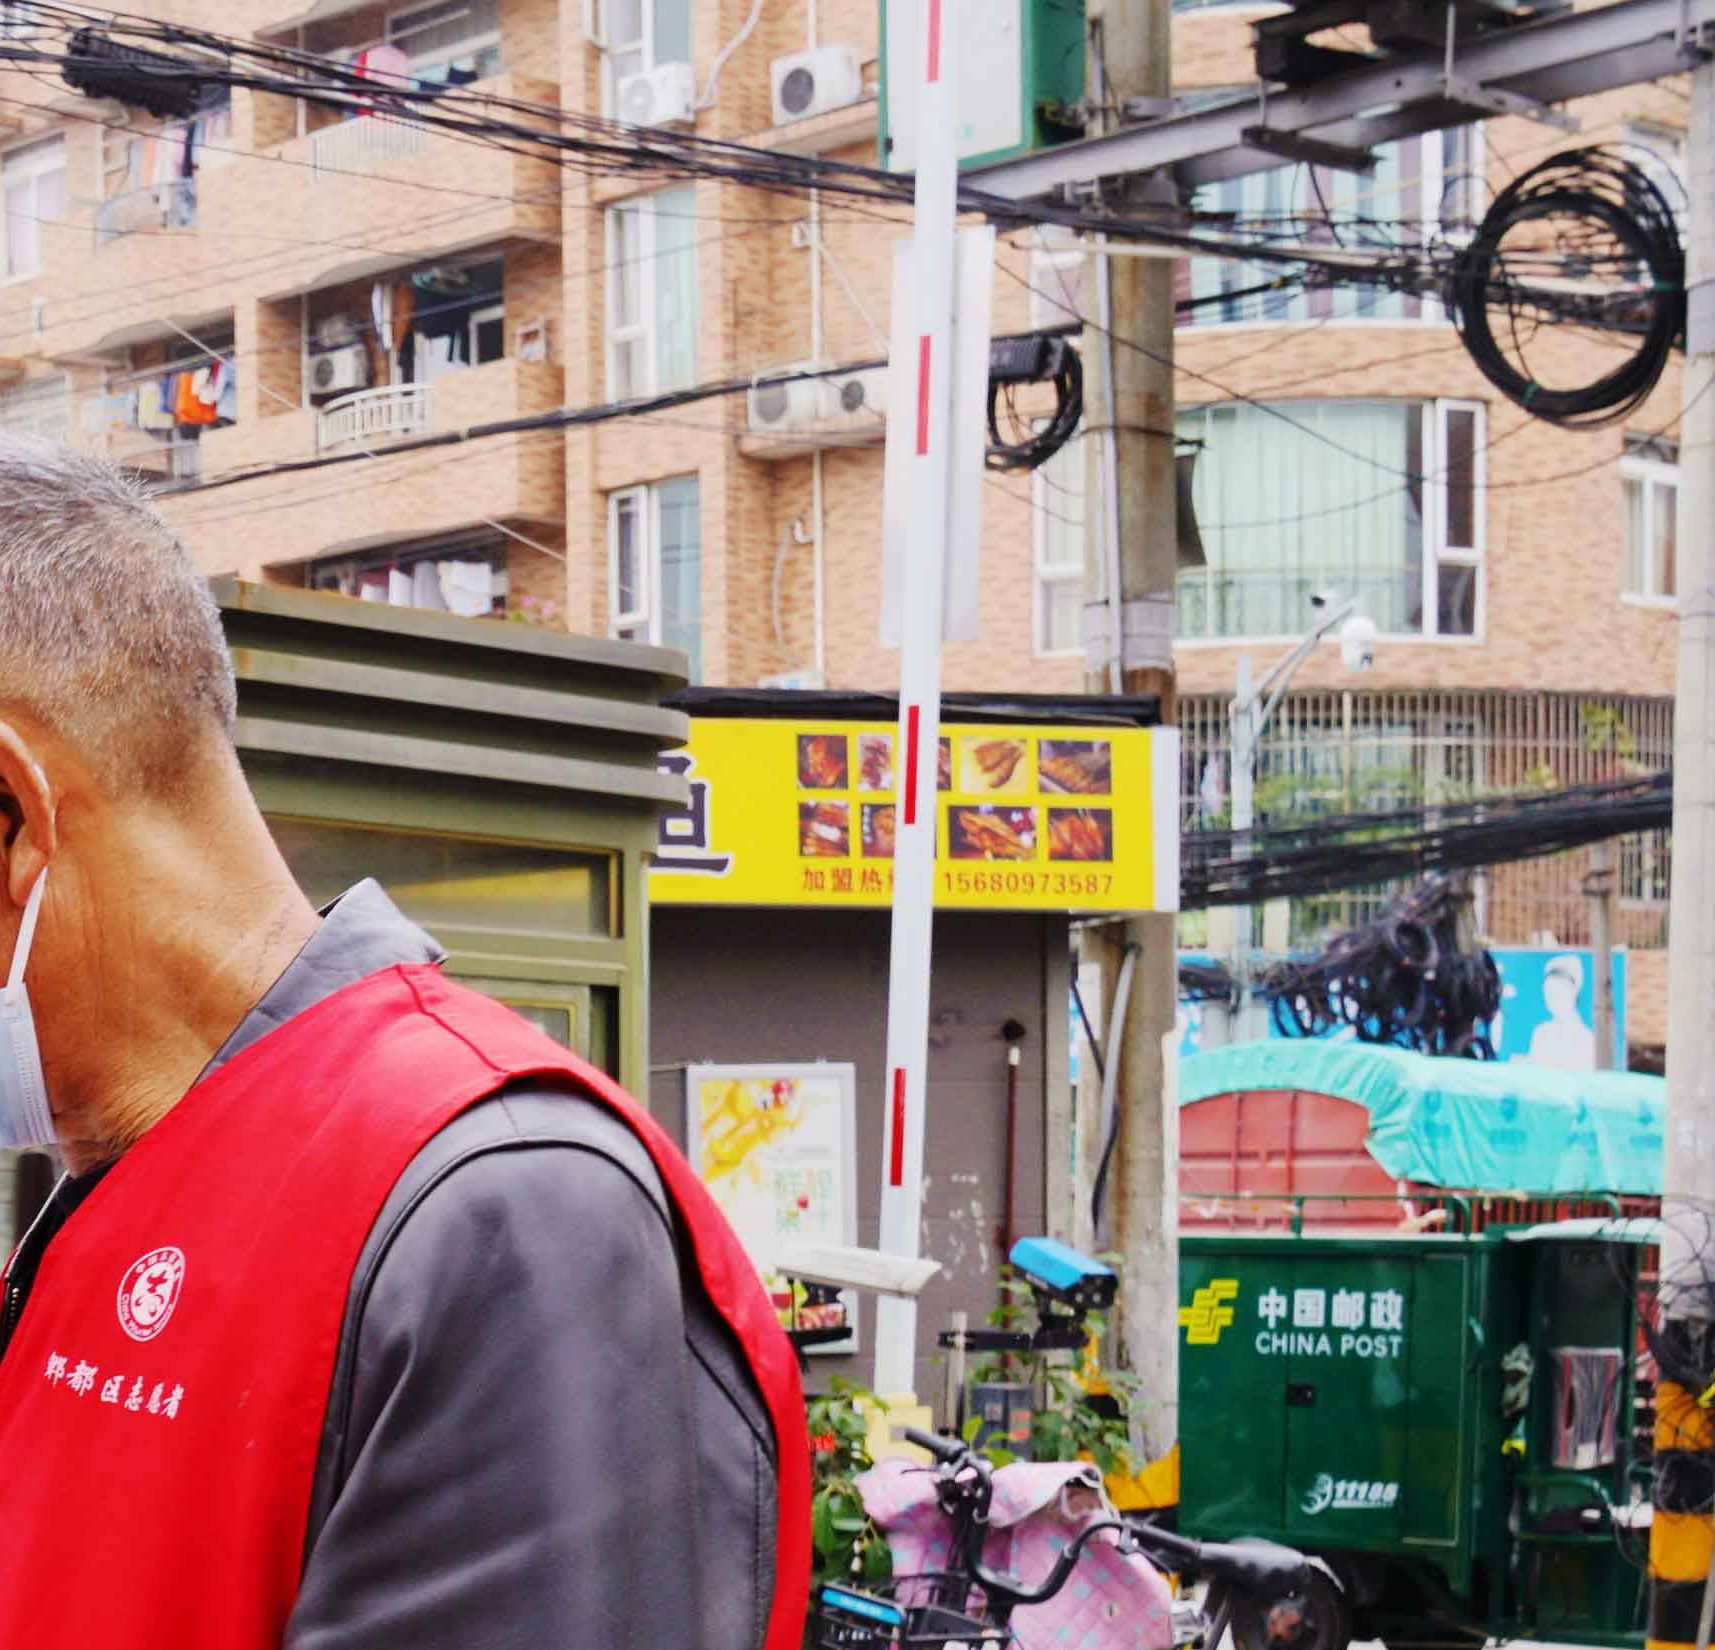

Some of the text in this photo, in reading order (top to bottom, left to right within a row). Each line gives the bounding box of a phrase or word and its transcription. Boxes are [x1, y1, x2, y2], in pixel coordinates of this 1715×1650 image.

[802, 867, 1115, 896] 加盟热 15680973587
[1258, 1286, 1404, 1330] 中国邮政
[1255, 1331, 1403, 1358] CHINA POST
